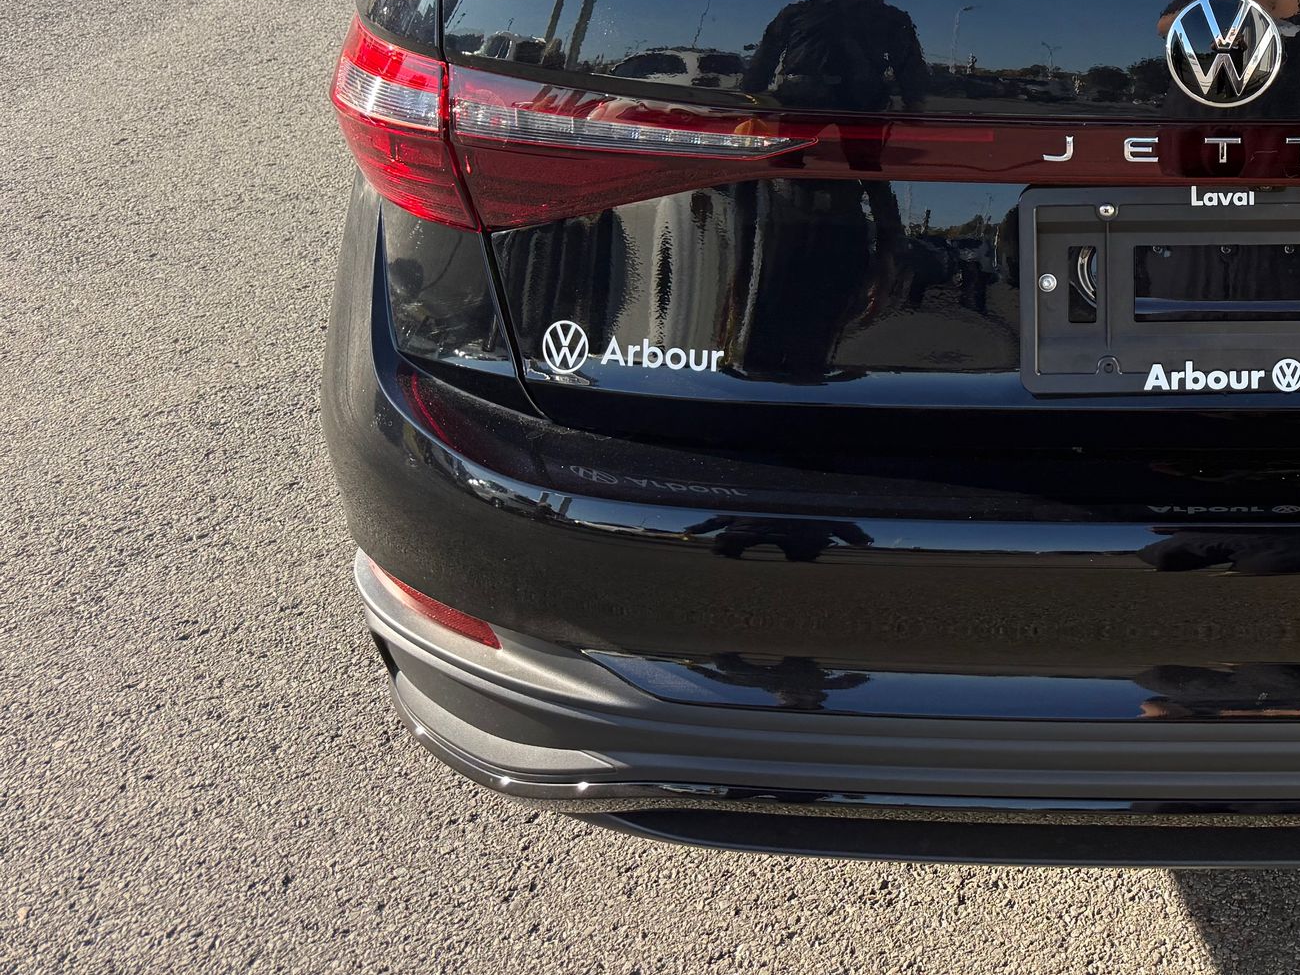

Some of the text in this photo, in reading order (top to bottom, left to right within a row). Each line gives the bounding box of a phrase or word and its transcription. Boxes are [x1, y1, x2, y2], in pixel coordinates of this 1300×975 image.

[1190, 185, 1255, 206] Laval
[600, 335, 725, 372] Arbour
[1143, 360, 1265, 391] Arbour
